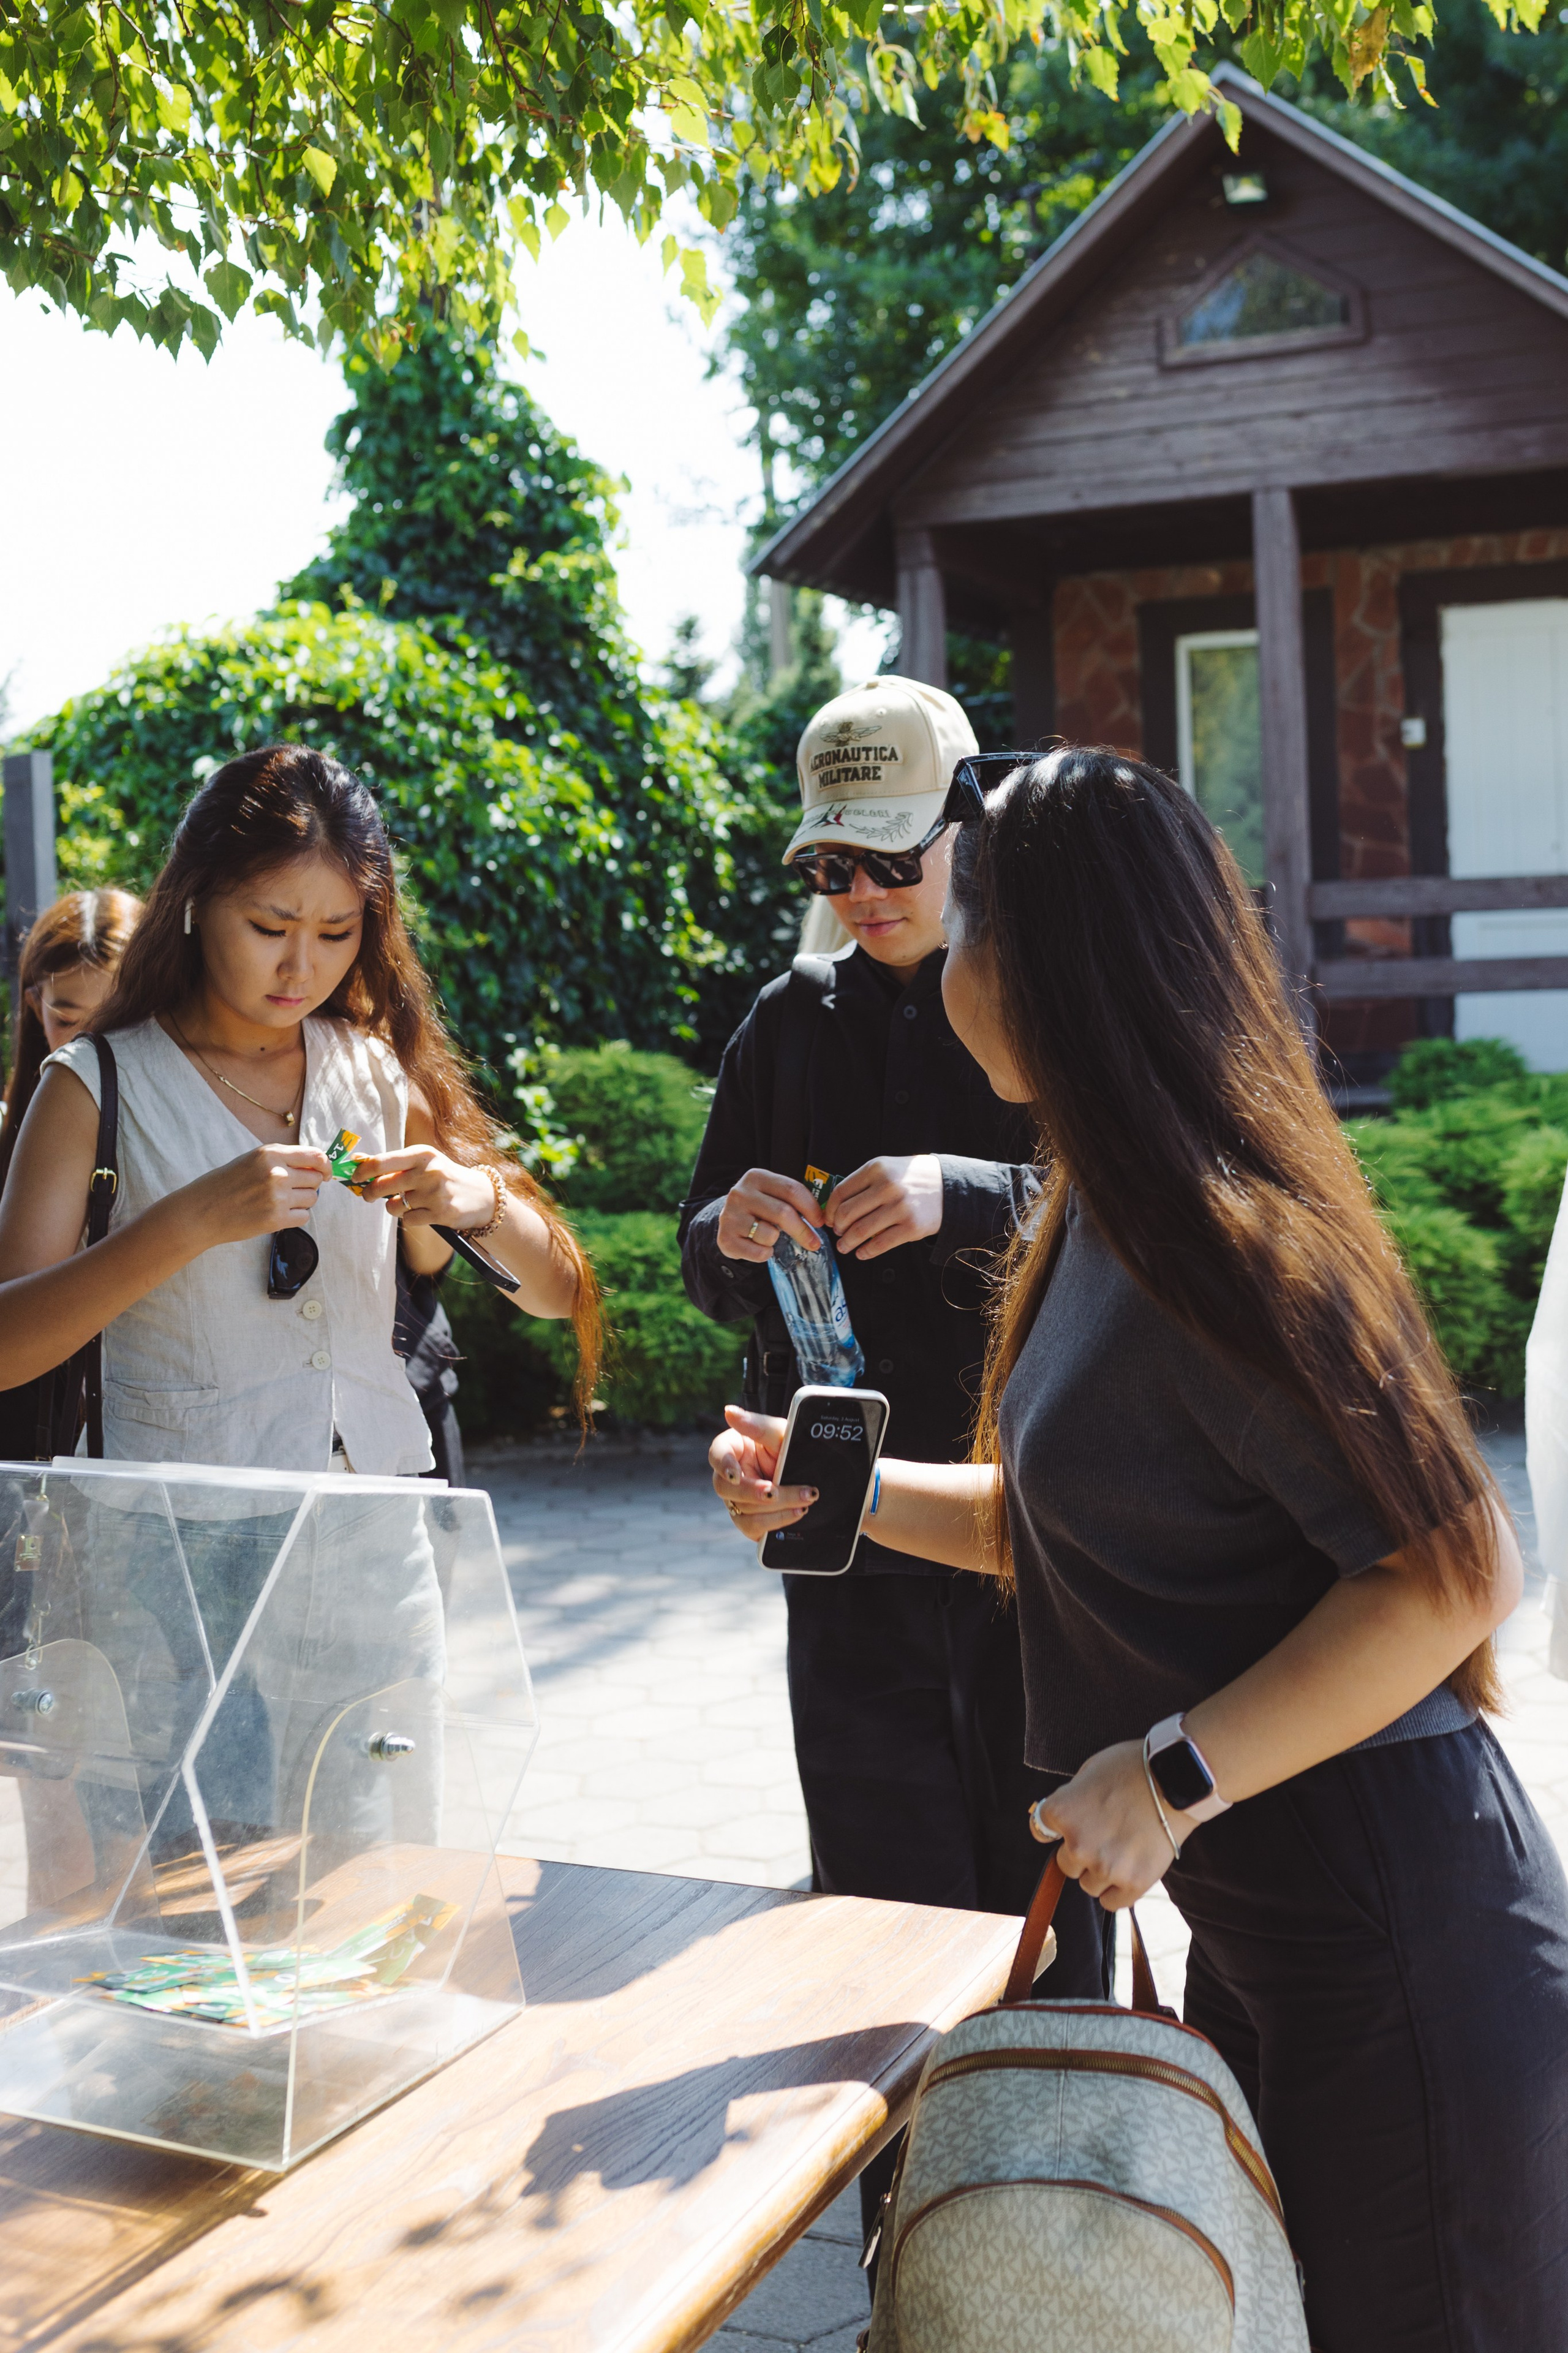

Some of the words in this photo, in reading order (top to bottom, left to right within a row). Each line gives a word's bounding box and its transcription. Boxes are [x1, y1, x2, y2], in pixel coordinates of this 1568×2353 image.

[810, 746, 899, 771] AERONAUTICA
[818, 766, 881, 788] MILITARE
[810, 1422, 864, 1441] 09:52
